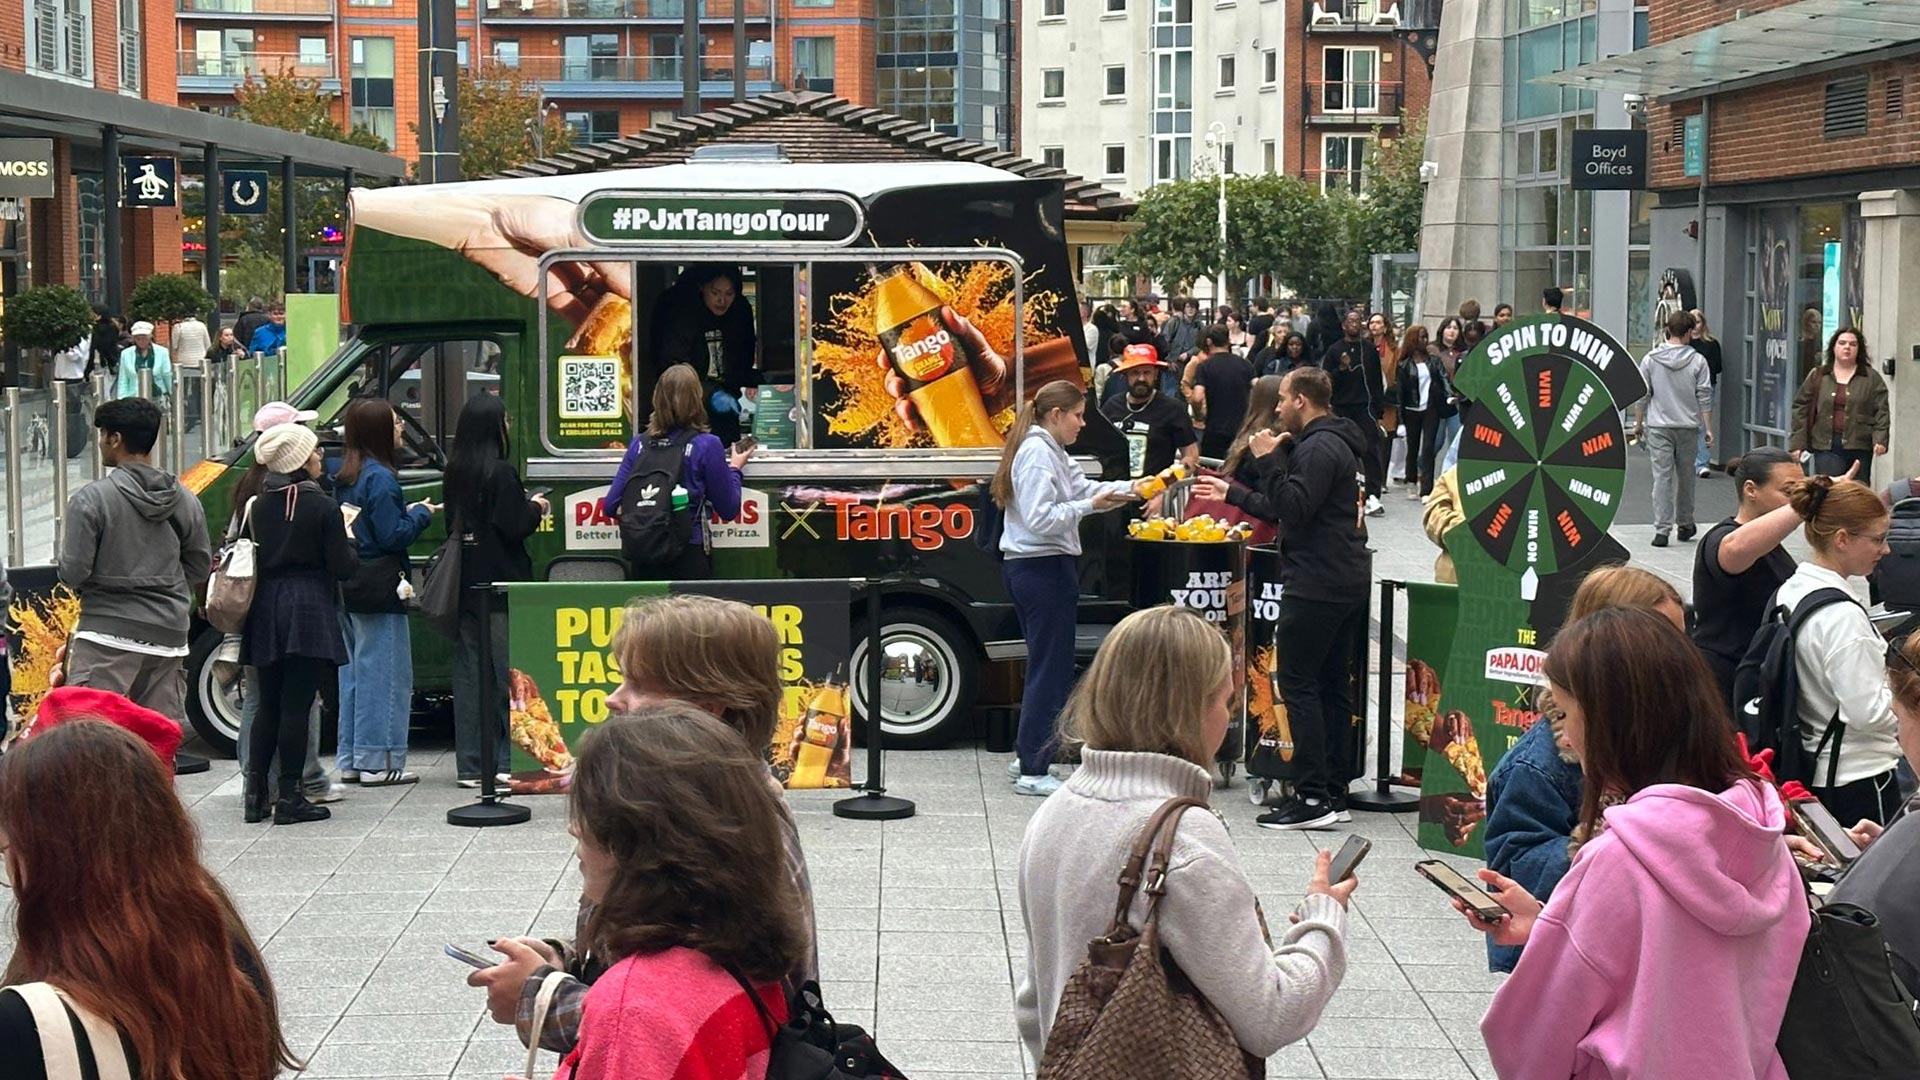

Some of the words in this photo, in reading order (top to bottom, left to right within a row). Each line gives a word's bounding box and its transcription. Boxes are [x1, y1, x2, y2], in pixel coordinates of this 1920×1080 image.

[1592, 145, 1627, 161] Boyd
[0, 161, 48, 176] MOSS
[1585, 161, 1633, 175] Offices
[613, 208, 829, 235] #PJxTangoTour
[891, 330, 950, 364] Tango
[1487, 325, 1536, 365] SPIN
[1540, 323, 1567, 347] TO
[1569, 328, 1614, 371] WIN
[1538, 370, 1552, 409] WIN
[1577, 383, 1595, 405] NO
[1496, 382, 1512, 402] NO
[1505, 401, 1526, 430] WIN
[1561, 404, 1583, 432] WIN
[1473, 423, 1504, 448] WIN
[1581, 431, 1613, 457] WIN
[1465, 480, 1483, 496] NO
[1482, 468, 1506, 487] WIN
[1568, 479, 1592, 498] WIN
[1593, 490, 1611, 506] NO
[825, 497, 974, 550] Tango
[1486, 503, 1513, 539] WIN
[1527, 509, 1539, 539] WIN
[1556, 509, 1582, 547] WIN
[576, 531, 612, 540] Better
[728, 528, 761, 538] Pizza.
[1527, 543, 1538, 562] NO
[1186, 571, 1232, 588] ARE
[1170, 589, 1227, 608] YOU
[1252, 599, 1280, 621] YO
[556, 607, 624, 647] PU
[1517, 628, 1536, 645] THE
[1490, 653, 1519, 671] PAPA
